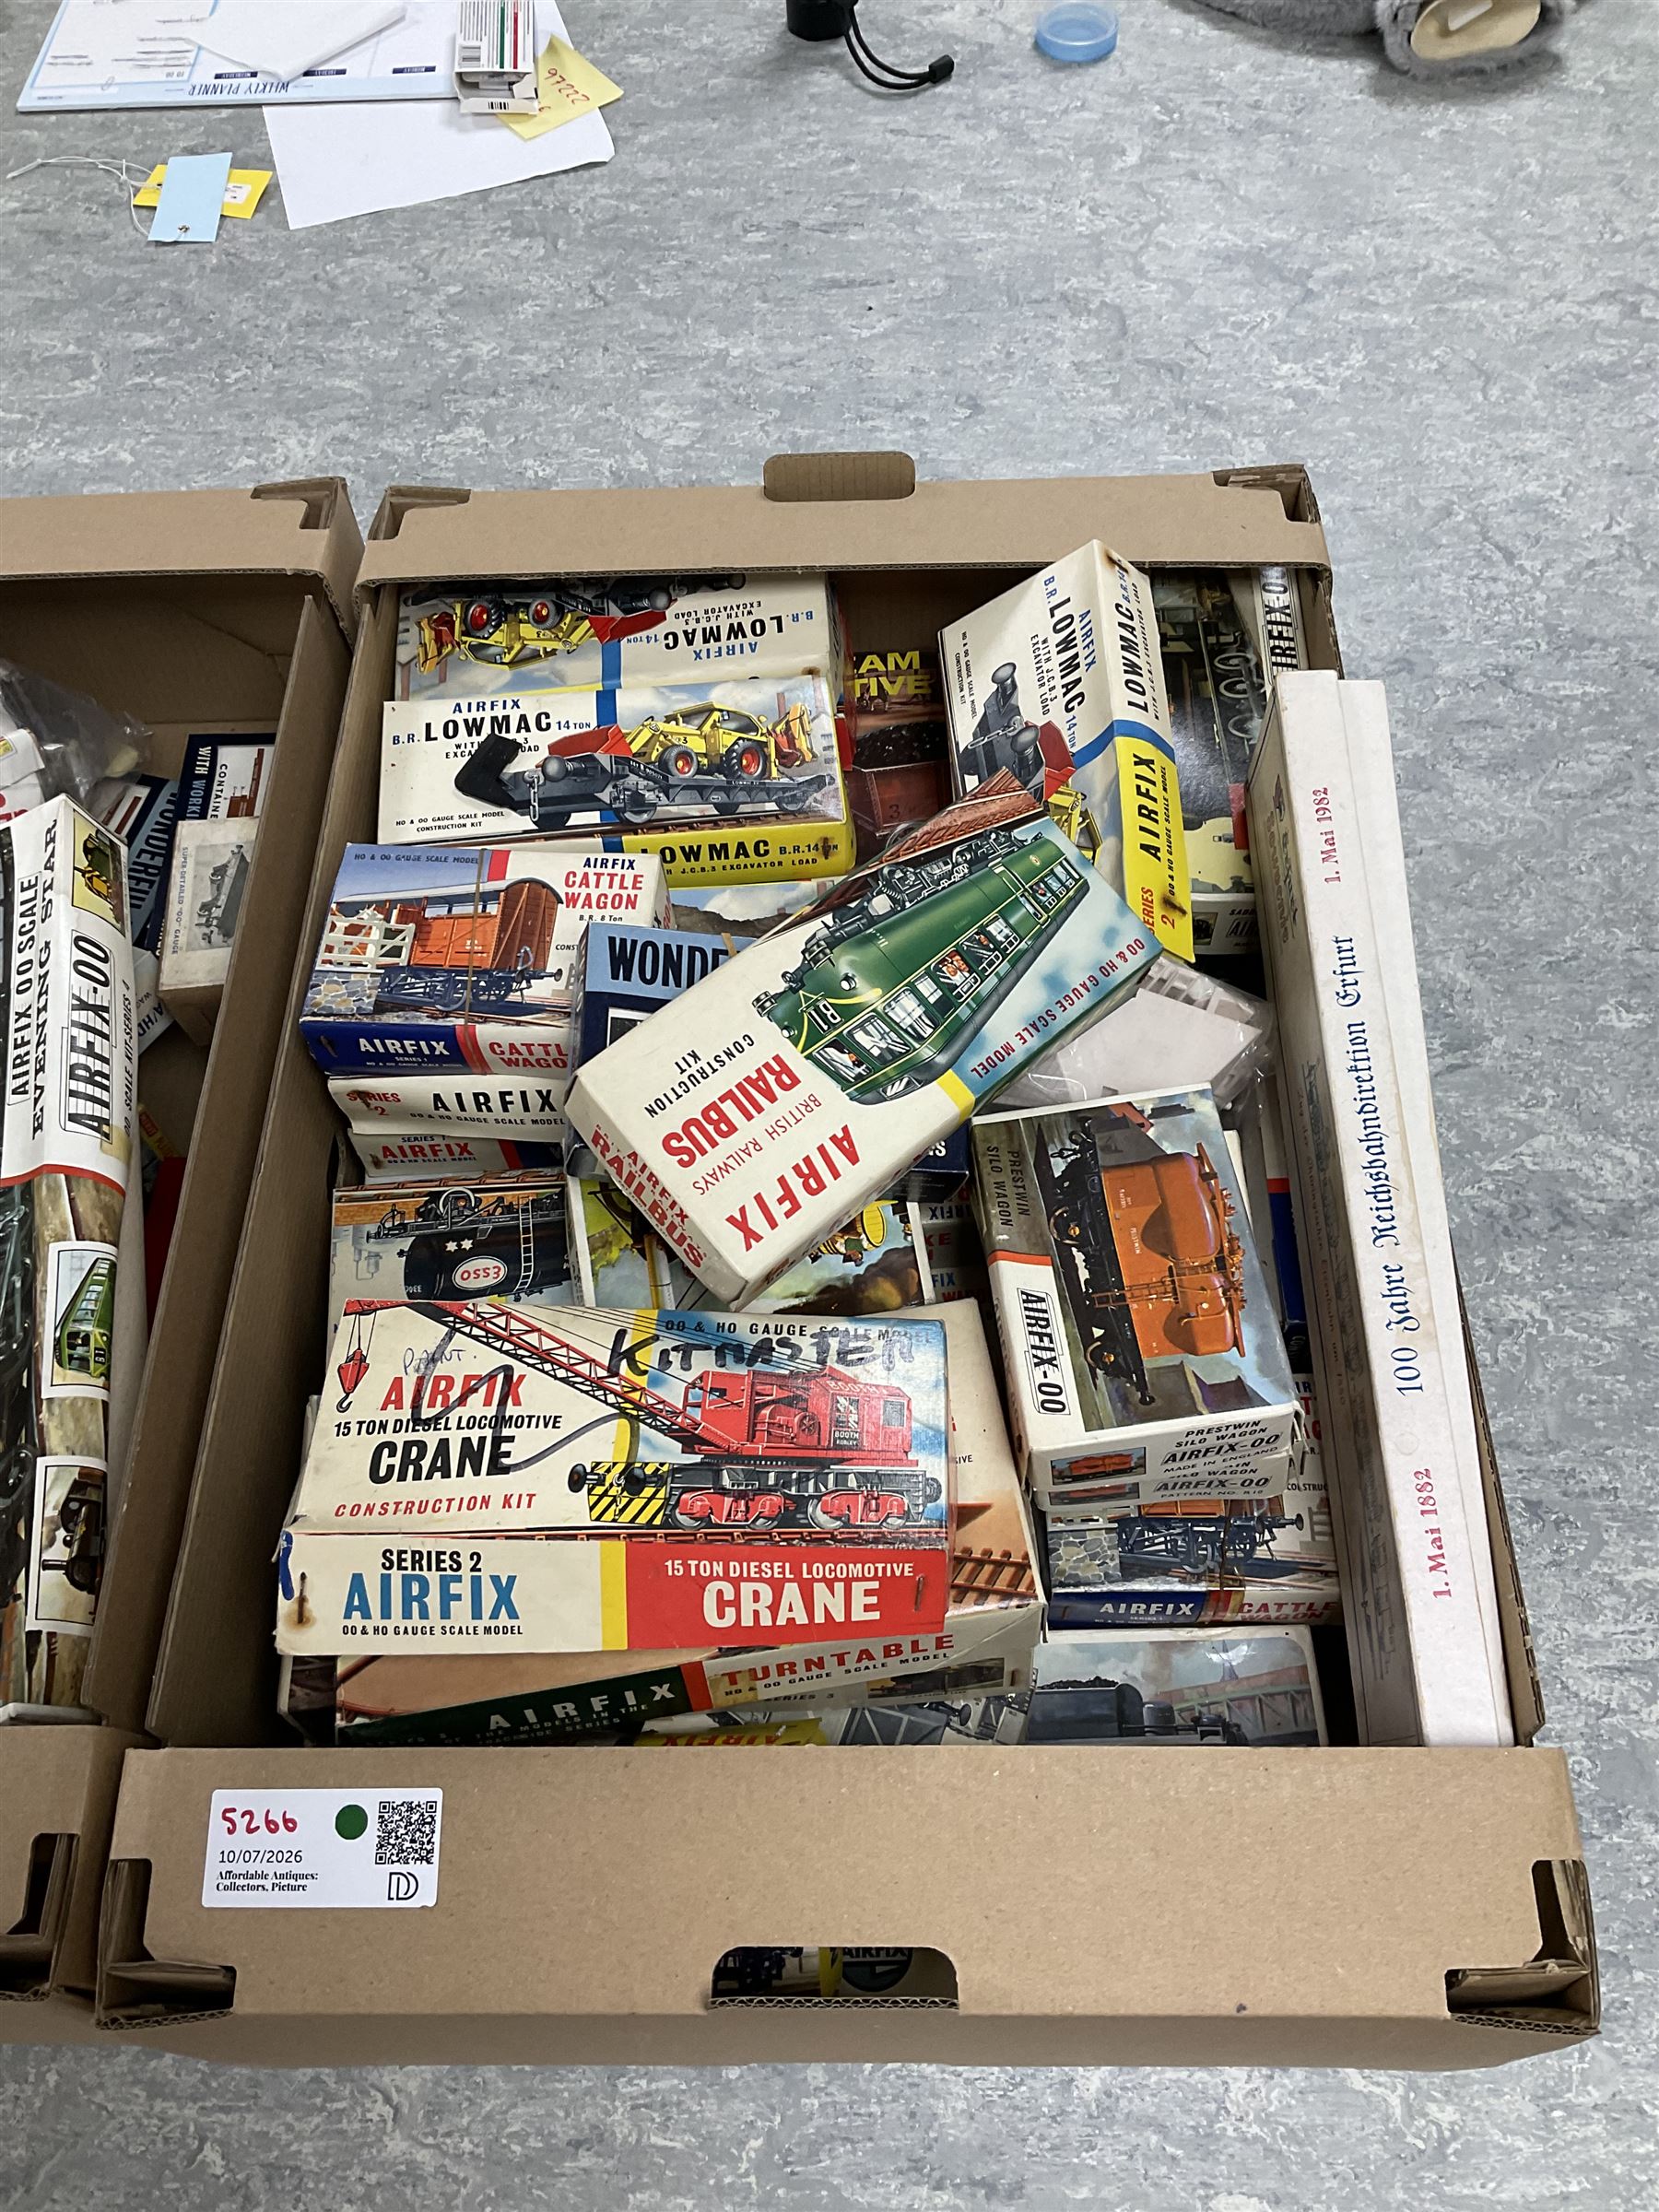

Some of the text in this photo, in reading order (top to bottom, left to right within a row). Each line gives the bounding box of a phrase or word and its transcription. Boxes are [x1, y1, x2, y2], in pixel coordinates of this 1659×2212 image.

[675, 601, 761, 619] EXCAVATOR LOAD
[726, 609, 754, 619] WITH
[1131, 582, 1151, 662] EXCAVATOR LOAD
[627, 615, 783, 650] LOWMAC 14 TON
[1078, 609, 1097, 673] AIRFIX
[693, 641, 758, 661] AIRFIX
[1041, 637, 1053, 664] WITH
[1044, 575, 1086, 748] B.R. LOWMAC 14 TON
[1114, 602, 1149, 714] LOWMAC
[955, 653, 965, 693] CONSTRUCTION
[1030, 634, 1050, 716] EXCAVATOR LOAD
[964, 659, 978, 719] GAUGE SCALE MODEL
[453, 699, 521, 713] AIRFIX
[393, 734, 420, 745] B.R.
[425, 712, 551, 742] LOWMAC
[556, 720, 571, 731] 14
[573, 722, 591, 730] TON
[194, 746, 212, 775] WITH
[1160, 767, 1169, 794] MODEL
[1133, 753, 1161, 863] AIRFIX
[417, 823, 466, 832] CONSTRUCTION
[1166, 827, 1174, 856] GAUGE
[1312, 786, 1341, 885] 1. Mai 1982
[453, 856, 479, 865] MODEL
[583, 857, 636, 871] AIRFIX
[723, 858, 818, 871] EXCAVATOR LOAD
[1168, 858, 1174, 873] HO
[565, 871, 644, 890] CATTLE
[565, 892, 639, 910] WAGON
[1160, 914, 1175, 930] 2
[11, 875, 40, 1096] AIRFIX SCALE
[32, 818, 58, 1141] EVENING STAR
[971, 959, 1119, 1078] HO GAUGE SCALE MODEL
[359, 1038, 450, 1055] AIRFIX
[644, 1033, 755, 1119] CONSTRUCTION
[674, 1050, 701, 1075] KIT
[124, 1068, 134, 1112] SCALE
[432, 1089, 558, 1113] AIRFIX
[373, 1106, 389, 1116] 2
[662, 1053, 802, 1169] RAILBUS
[382, 1142, 476, 1159] AIRFIX
[692, 1093, 822, 1195] BRITISH RAILWAYS
[1333, 935, 1424, 1397] 100 Reichsbahndirektion Erfurt
[627, 1150, 689, 1226] AIRFIX
[724, 1124, 860, 1253] AIRFIX
[986, 1145, 1014, 1227] SILO WAGON
[1007, 1150, 1030, 1217] PRESTWIN
[591, 1129, 703, 1268] RAILBUS
[716, 1322, 808, 1336] HO GAUGE
[380, 1374, 527, 1411] AIRFIX
[335, 1415, 562, 1437] 15 TON DIESEL LOCOMOTIVE
[1175, 1428, 1267, 1448] SILO WAGON
[1185, 1420, 1262, 1438] PRESTWIN
[369, 1435, 515, 1485] CRANE
[1163, 1464, 1197, 1473] MADE
[1222, 1447, 1278, 1463] ENGLAND
[335, 1493, 536, 1517] CONSTRUCTION KIT
[1414, 1468, 1452, 1599] 1. Mai 1882
[382, 1548, 482, 1572] SERIES 2
[665, 1559, 914, 1579] 15 TON DIESEL LOCOMOTIVE
[343, 1573, 521, 1620] AIRFIX
[703, 1580, 880, 1628] CRANE
[1100, 1603, 1194, 1616] AIRFIX
[1242, 1602, 1336, 1613] CATTLE
[373, 1625, 524, 1636] HO GAUGE SCALE MODEL
[723, 1634, 955, 1687] TURNTABLE
[788, 1653, 950, 1685] GAUGE SCALE MODEL
[489, 1683, 676, 1731] AIRFIX
[221, 1807, 298, 1835] 5266
[218, 1850, 302, 1864] 10/07/2026
[216, 1870, 318, 1882] Affordable Antiques:
[216, 1882, 307, 1893] Collectors, Picture
